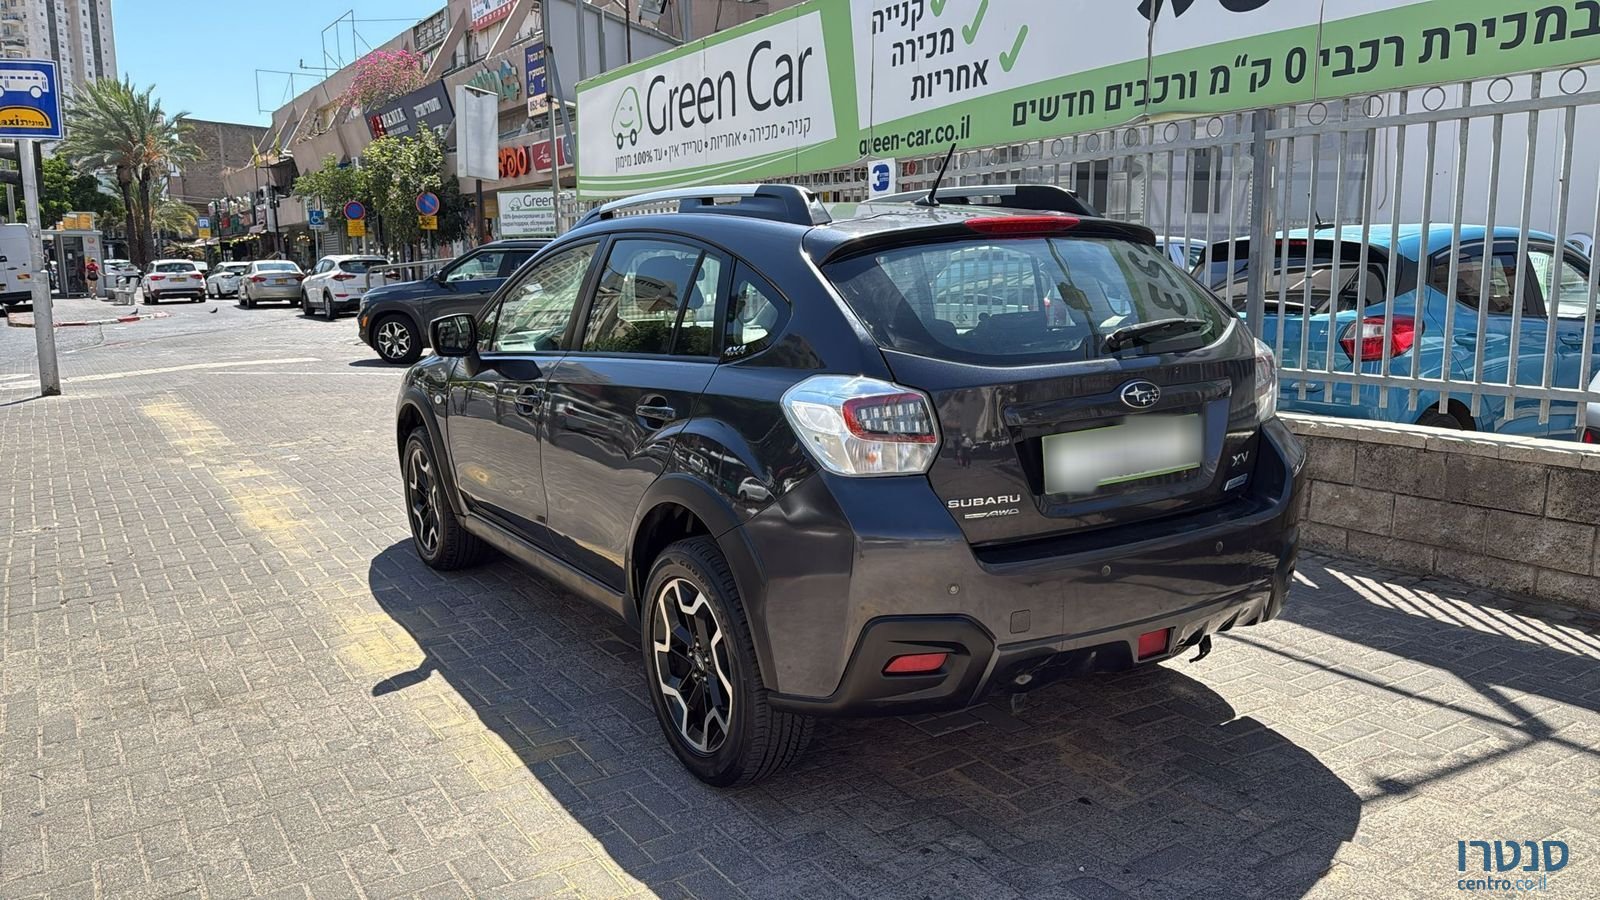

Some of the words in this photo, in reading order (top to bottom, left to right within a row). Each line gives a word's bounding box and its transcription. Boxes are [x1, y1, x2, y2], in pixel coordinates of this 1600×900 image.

[872, 0, 925, 36] קנייה
[1418, 0, 1600, 65] במכירת
[892, 28, 955, 67] מכירה
[1318, 35, 1405, 78] רכבי
[1284, 46, 1307, 84] 0
[646, 70, 736, 136] Green
[746, 40, 814, 112] Car
[911, 60, 990, 101] אחריות
[1104, 70, 1199, 112] ורכבים
[1012, 88, 1096, 127] חדשים
[0, 114, 19, 126] axi
[787, 117, 812, 138] קניה
[709, 131, 742, 151] אחריות
[749, 123, 779, 144] מכירה
[859, 114, 971, 157] green-car.co.il
[653, 148, 663, 162] עד
[668, 143, 681, 163] אין
[682, 138, 703, 156] טרייד
[615, 153, 632, 173] מימון
[633, 150, 653, 167] 100%
[523, 194, 555, 207] Green
[1232, 450, 1249, 467] XV
[947, 493, 1021, 509] SUBARU
[986, 508, 1020, 518] AWD
